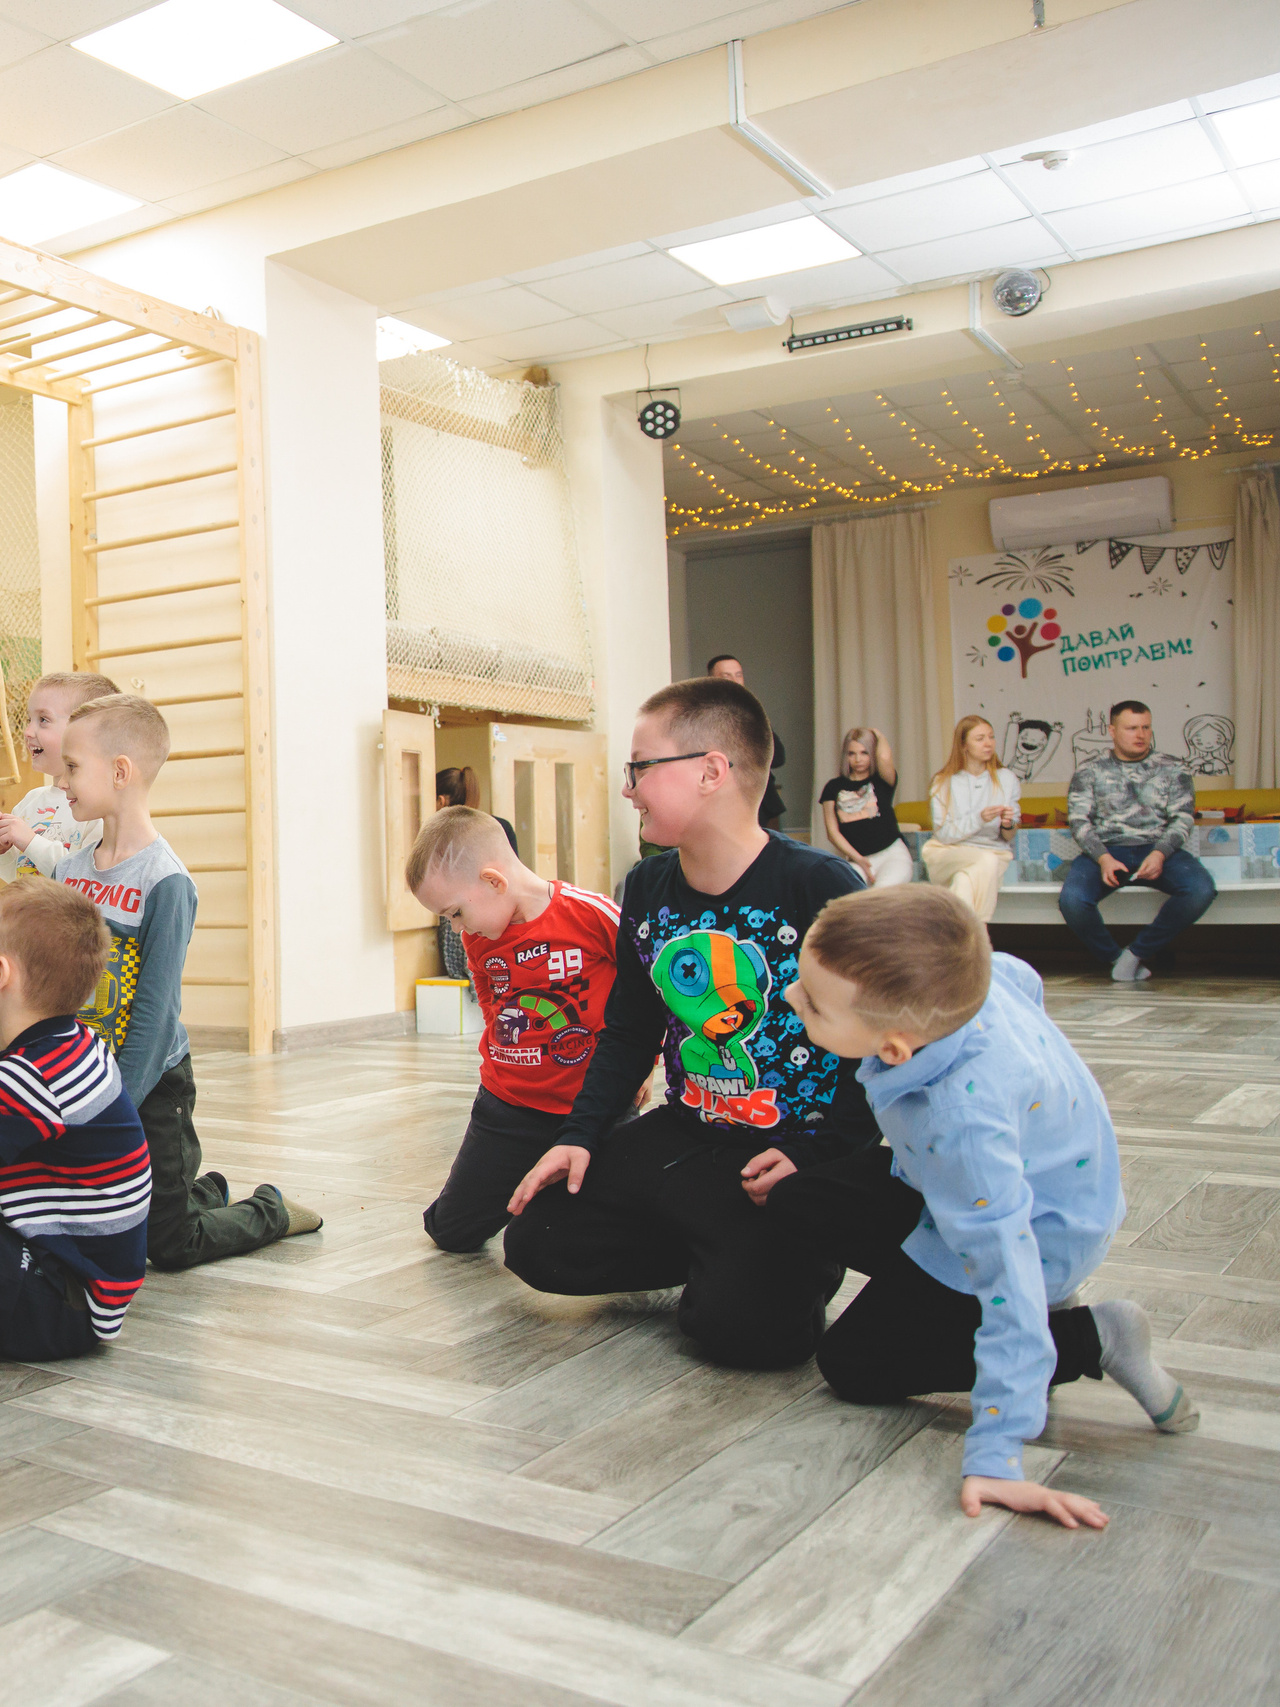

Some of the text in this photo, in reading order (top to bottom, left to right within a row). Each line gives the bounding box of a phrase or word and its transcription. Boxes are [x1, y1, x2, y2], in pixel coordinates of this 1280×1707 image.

[1059, 622, 1135, 655] ДАВАЙ
[1062, 638, 1194, 676] ПОИГРАЕМ!
[517, 944, 548, 963] RACE
[548, 948, 582, 980] 99
[556, 1027, 588, 1040] CHAMPIONSHIP
[488, 1044, 540, 1064] EAMWORK
[551, 1037, 592, 1052] RACING
[557, 1050, 588, 1064] TOURNAMENT
[687, 1072, 750, 1095] BRAWL
[680, 1078, 780, 1128] STARS
